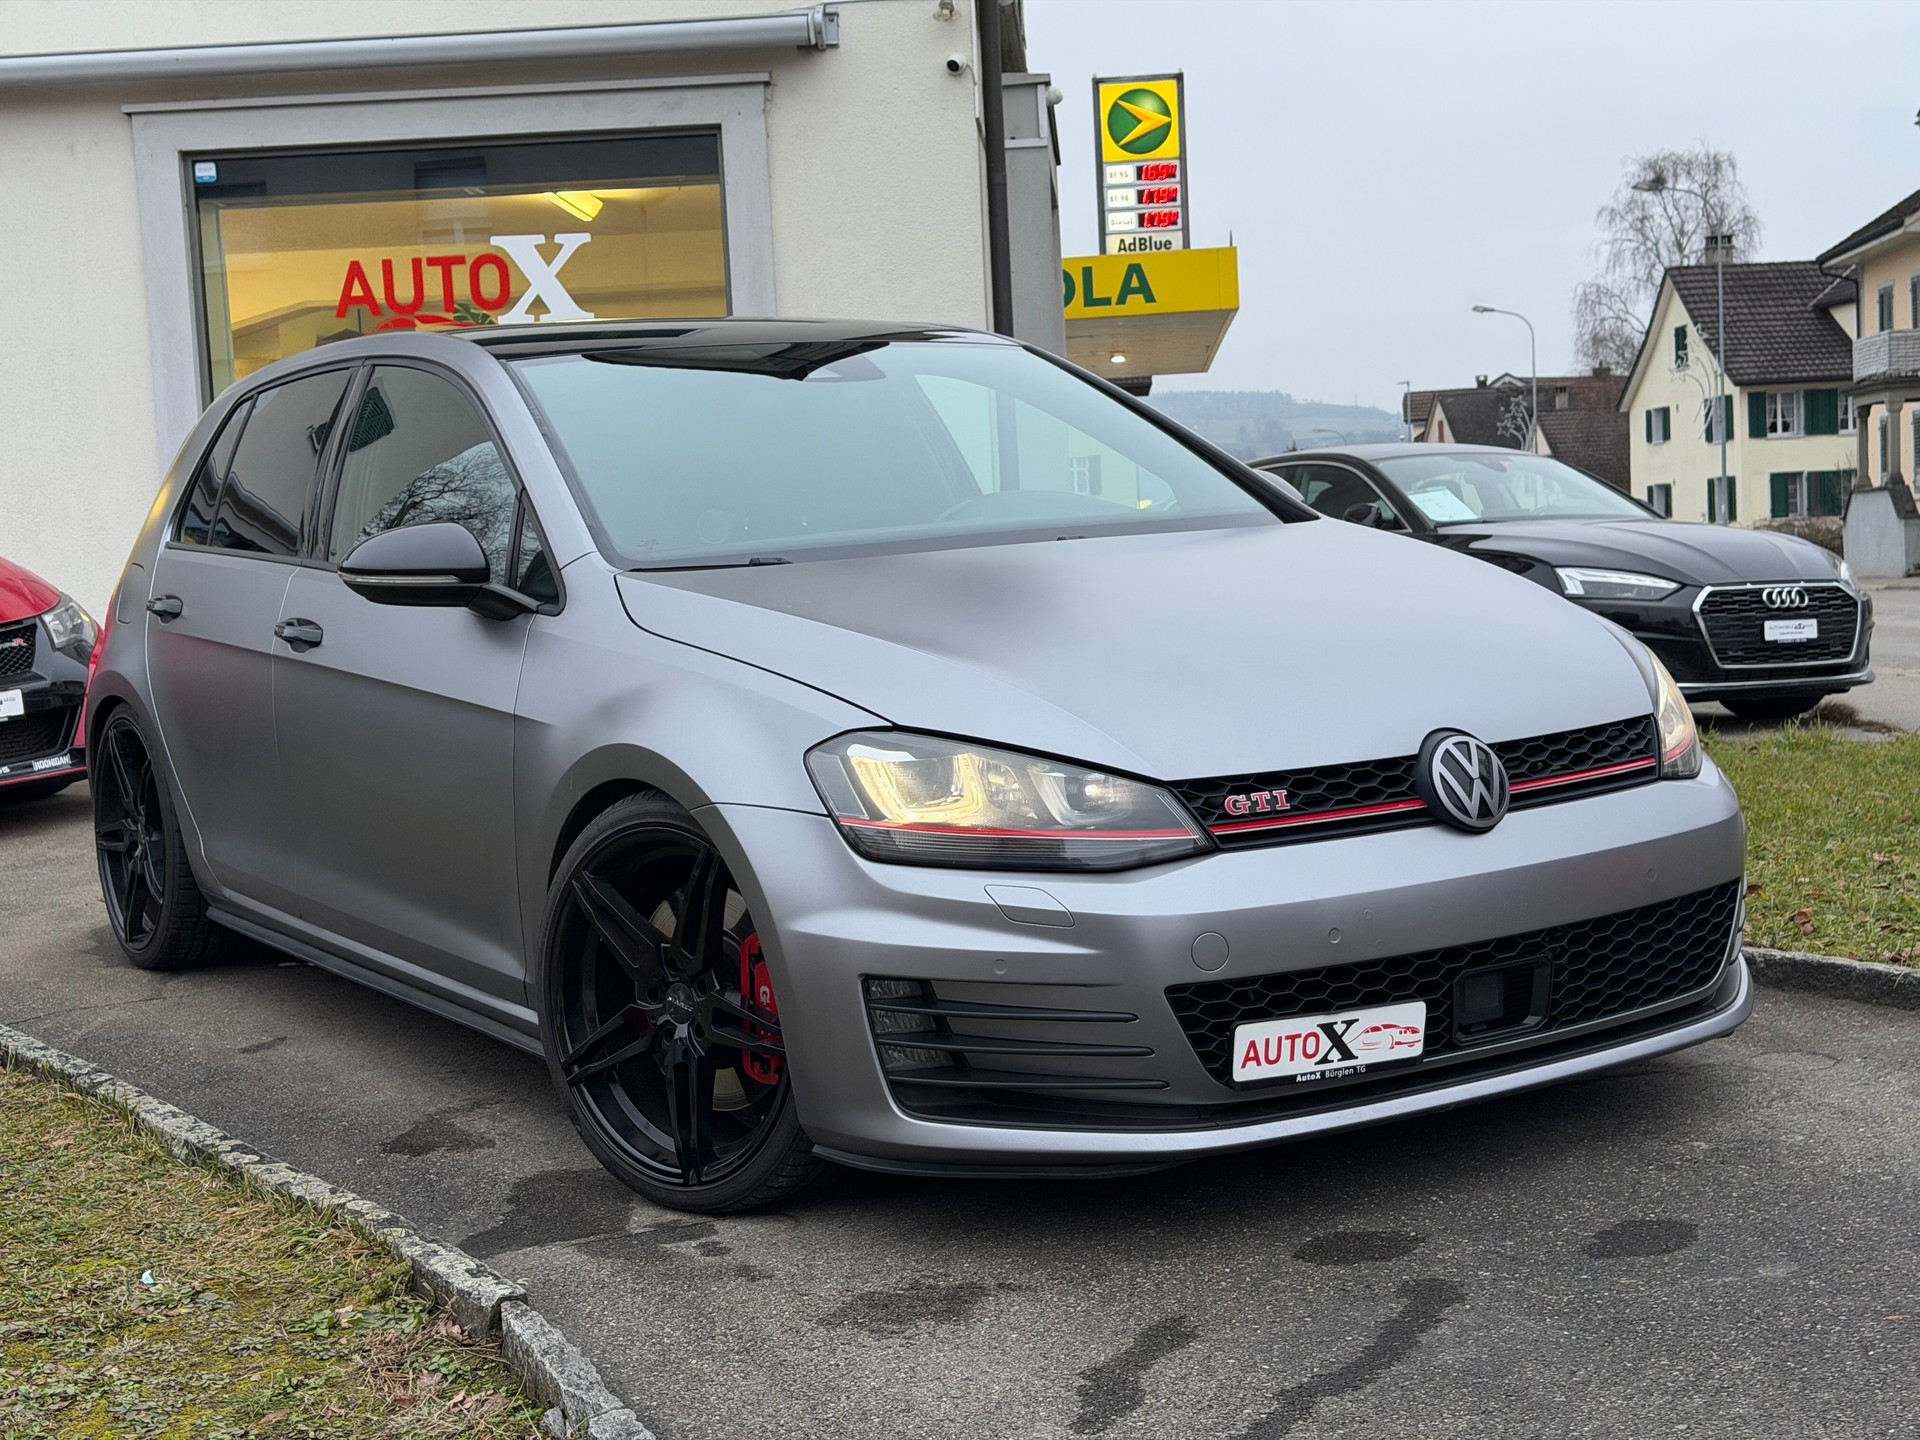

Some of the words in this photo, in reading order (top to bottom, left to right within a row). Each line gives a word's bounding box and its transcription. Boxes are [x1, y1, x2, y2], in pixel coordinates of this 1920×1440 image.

[1117, 235, 1173, 253] AdBlue
[1224, 790, 1290, 816] GTI
[1296, 1071, 1321, 1083] AutoX
[1325, 1068, 1354, 1078] Bürglen
[1356, 1065, 1366, 1073] TG
